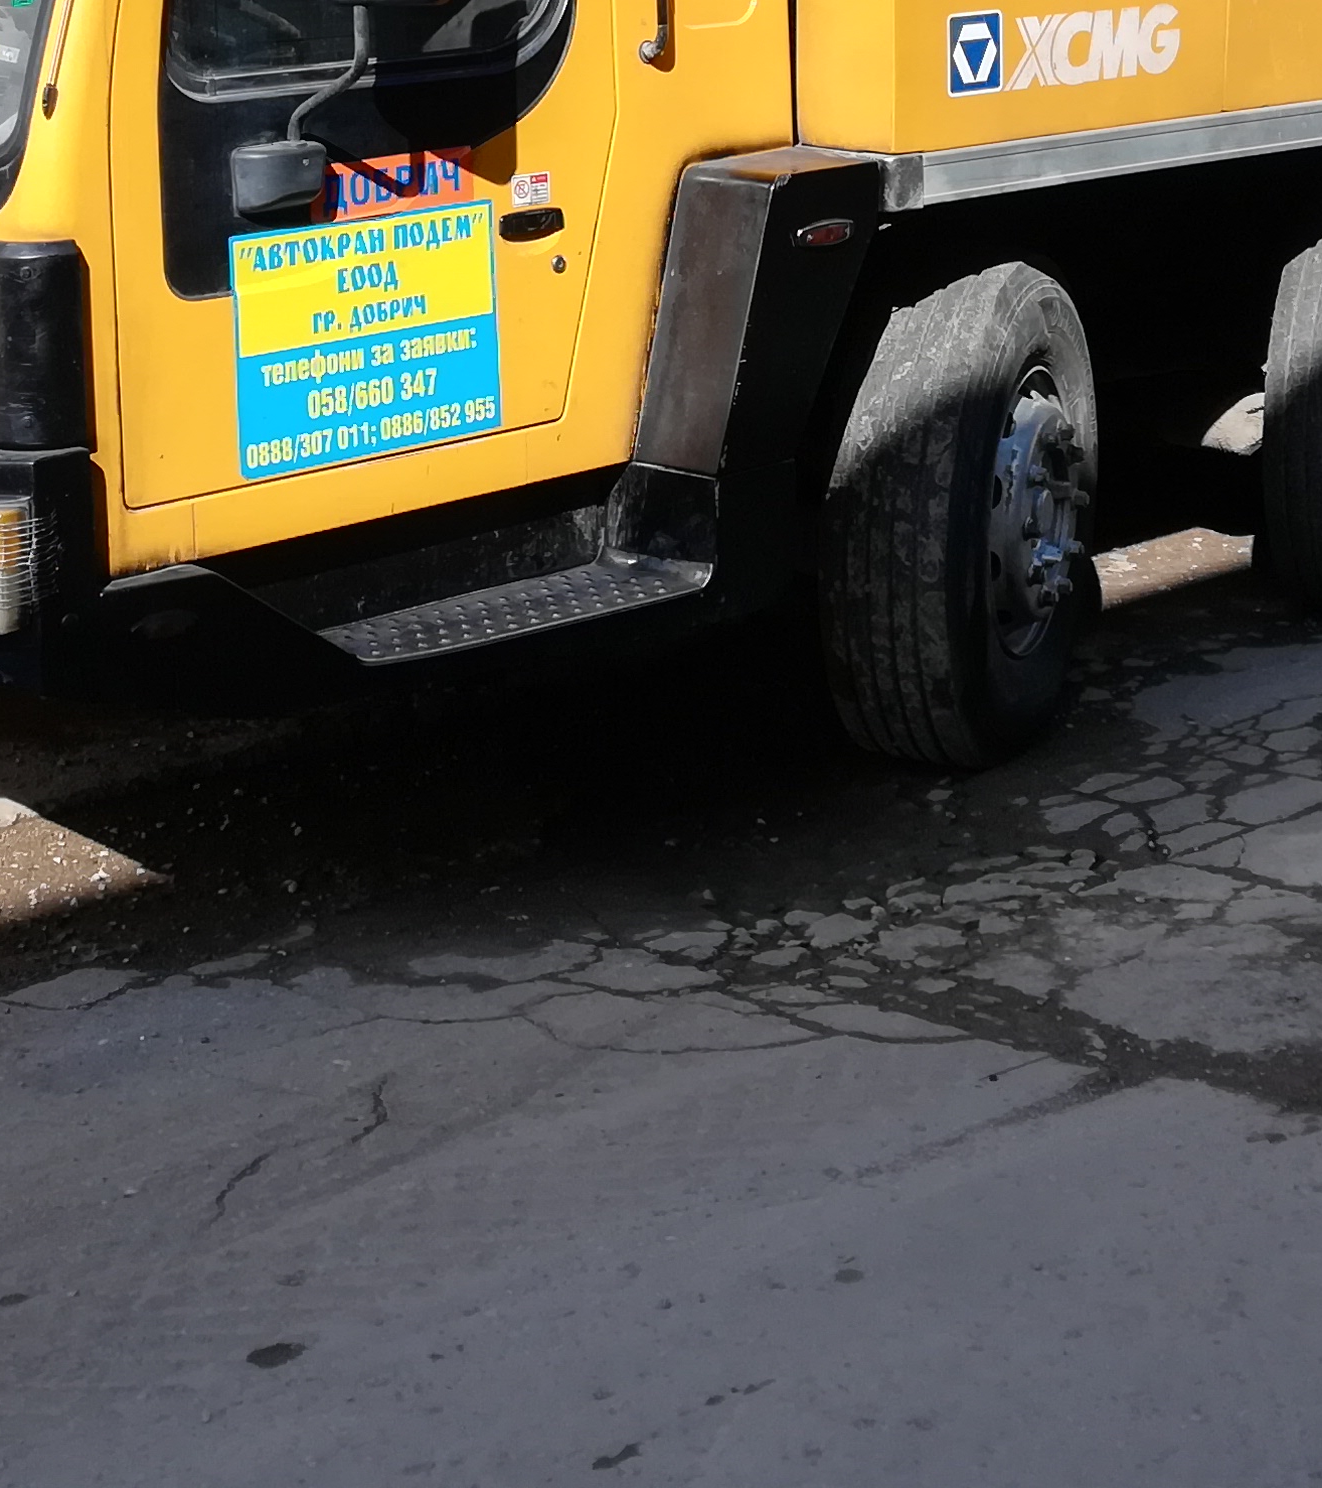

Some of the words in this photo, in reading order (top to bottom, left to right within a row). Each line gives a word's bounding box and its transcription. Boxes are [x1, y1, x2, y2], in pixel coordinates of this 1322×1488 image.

[1003, 3, 1181, 92] XCMG
[337, 260, 399, 294] ЕООД
[312, 310, 343, 335] ГР.
[349, 294, 427, 334] ДОБРИЧ
[261, 349, 365, 387] телефони
[371, 344, 395, 367] за
[399, 327, 478, 360] заявки:
[307, 376, 394, 420] 058/660
[400, 367, 438, 402] 347
[246, 428, 333, 469] 0888/307
[336, 421, 378, 448] 011;
[380, 402, 462, 436] 0886/852
[464, 395, 496, 423] 955
